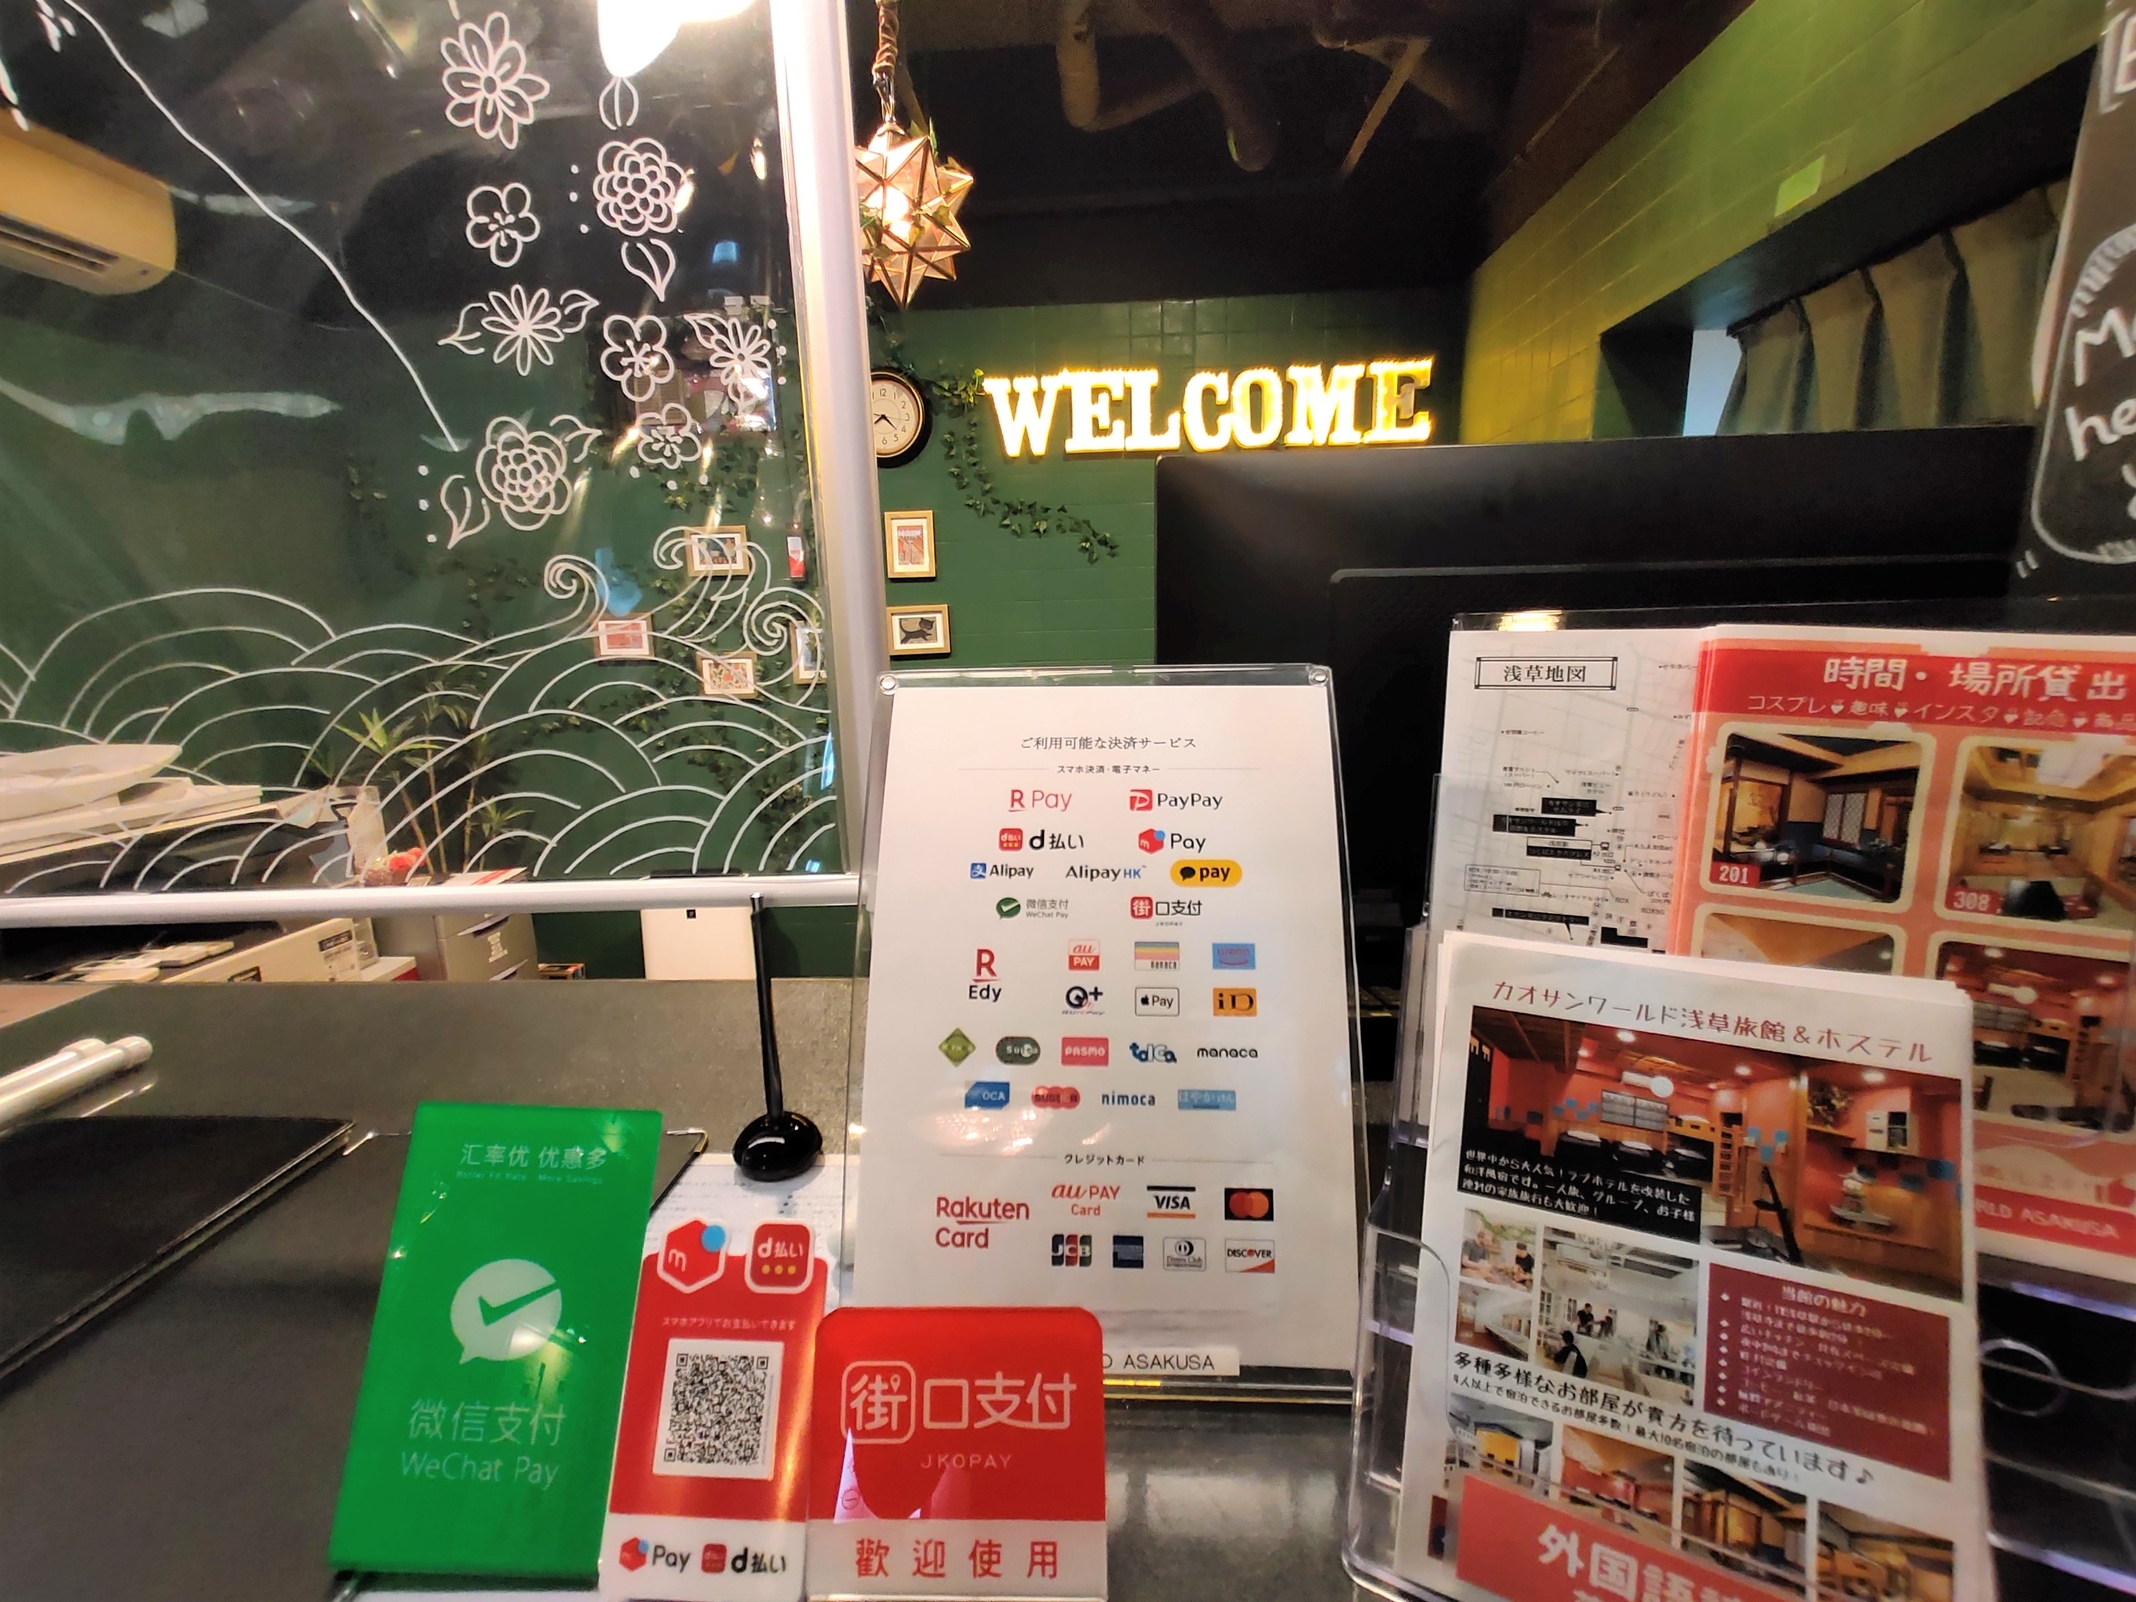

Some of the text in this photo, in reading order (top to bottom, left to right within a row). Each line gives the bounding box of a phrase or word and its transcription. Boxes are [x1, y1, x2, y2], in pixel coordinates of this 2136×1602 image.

[984, 356, 1435, 458] WELCOME
[1504, 665, 1587, 683] 浅草地図
[1747, 695, 1826, 713] コスプレ
[1912, 703, 1999, 723] インスタ
[1020, 736, 1197, 751] ご利用可能な決済サービス
[1056, 764, 1161, 775] スマホ決済・電子マネー
[1031, 789, 1073, 812] Pay
[1156, 792, 1223, 811] PayPay
[1170, 833, 1207, 853] Pay
[989, 864, 1034, 880] Alipay
[1200, 865, 1231, 882] pay
[1718, 866, 1749, 885] 201
[1026, 898, 1070, 911] 微信支付
[1026, 910, 1069, 920] WeChat Pay
[1072, 942, 1095, 955] au
[1073, 956, 1095, 967] PAY
[968, 985, 1002, 1003] Edy
[1151, 996, 1174, 1009] Pay
[1216, 992, 1254, 1011] iD
[1064, 1045, 1106, 1058] PASMO
[1196, 1047, 1258, 1059] manaca
[1101, 1090, 1156, 1106] nimoca
[460, 1143, 608, 1171] 汇率优 优惠多
[1064, 1153, 1145, 1166] クレジットカード
[1051, 1184, 1121, 1201] au PAY
[936, 1196, 1030, 1221] Rakuten
[1071, 1203, 1101, 1217] Card
[1154, 1195, 1191, 1211] VISA
[935, 1227, 990, 1249] Card
[757, 1237, 804, 1259] d払い
[1226, 1248, 1272, 1259] DISCOVER
[1124, 1354, 1215, 1372] ASAKUSA
[849, 1371, 1078, 1431] 街口支付
[407, 1398, 567, 1447] 微信支付
[401, 1450, 559, 1490] WeChat Pay
[920, 1453, 1013, 1471] JKOPAY
[652, 1544, 787, 1574] Pay d払い
[855, 1538, 1059, 1580] 歡迎使用
[1538, 1524, 1742, 1602] 外国語
